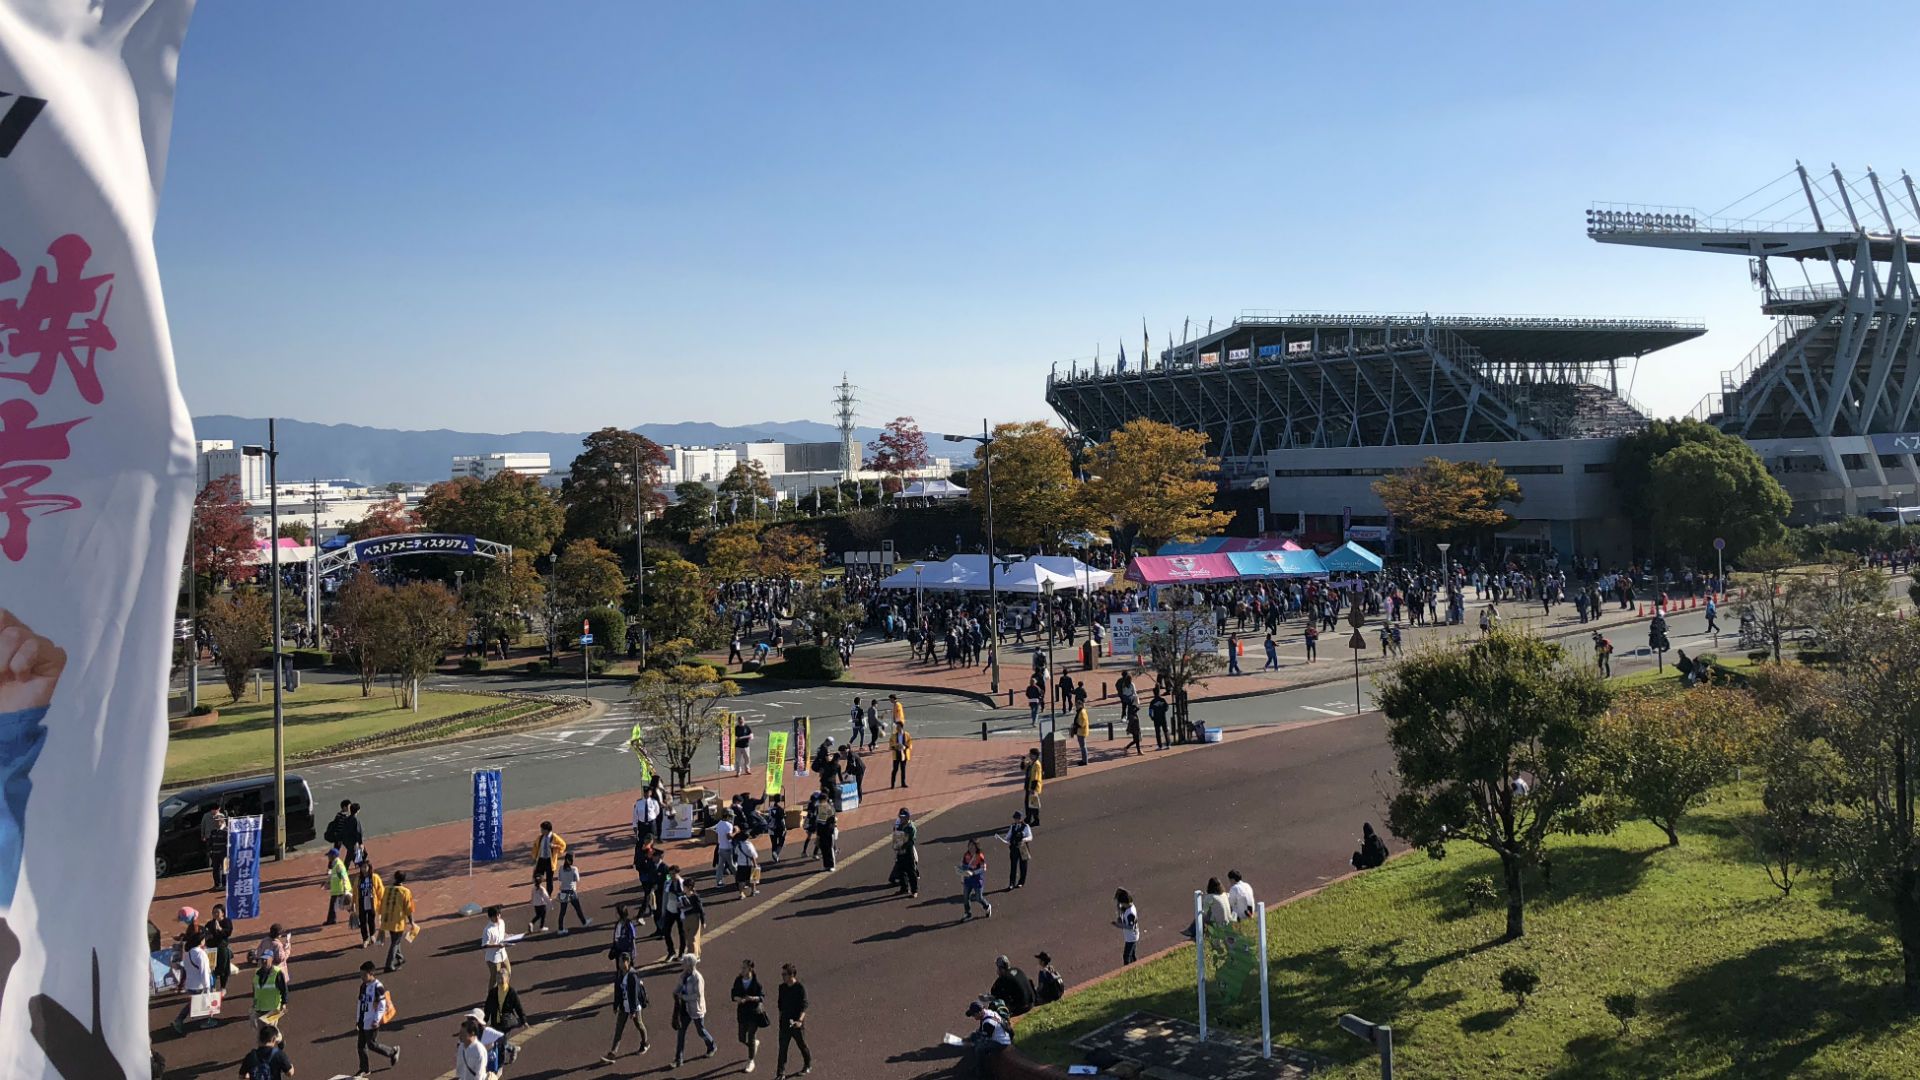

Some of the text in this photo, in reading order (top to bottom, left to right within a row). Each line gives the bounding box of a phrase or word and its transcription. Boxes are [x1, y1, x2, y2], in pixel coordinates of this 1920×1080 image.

[363, 539, 469, 555] ベストアメニティスタジアム
[234, 832, 254, 918] 限界は超えた
